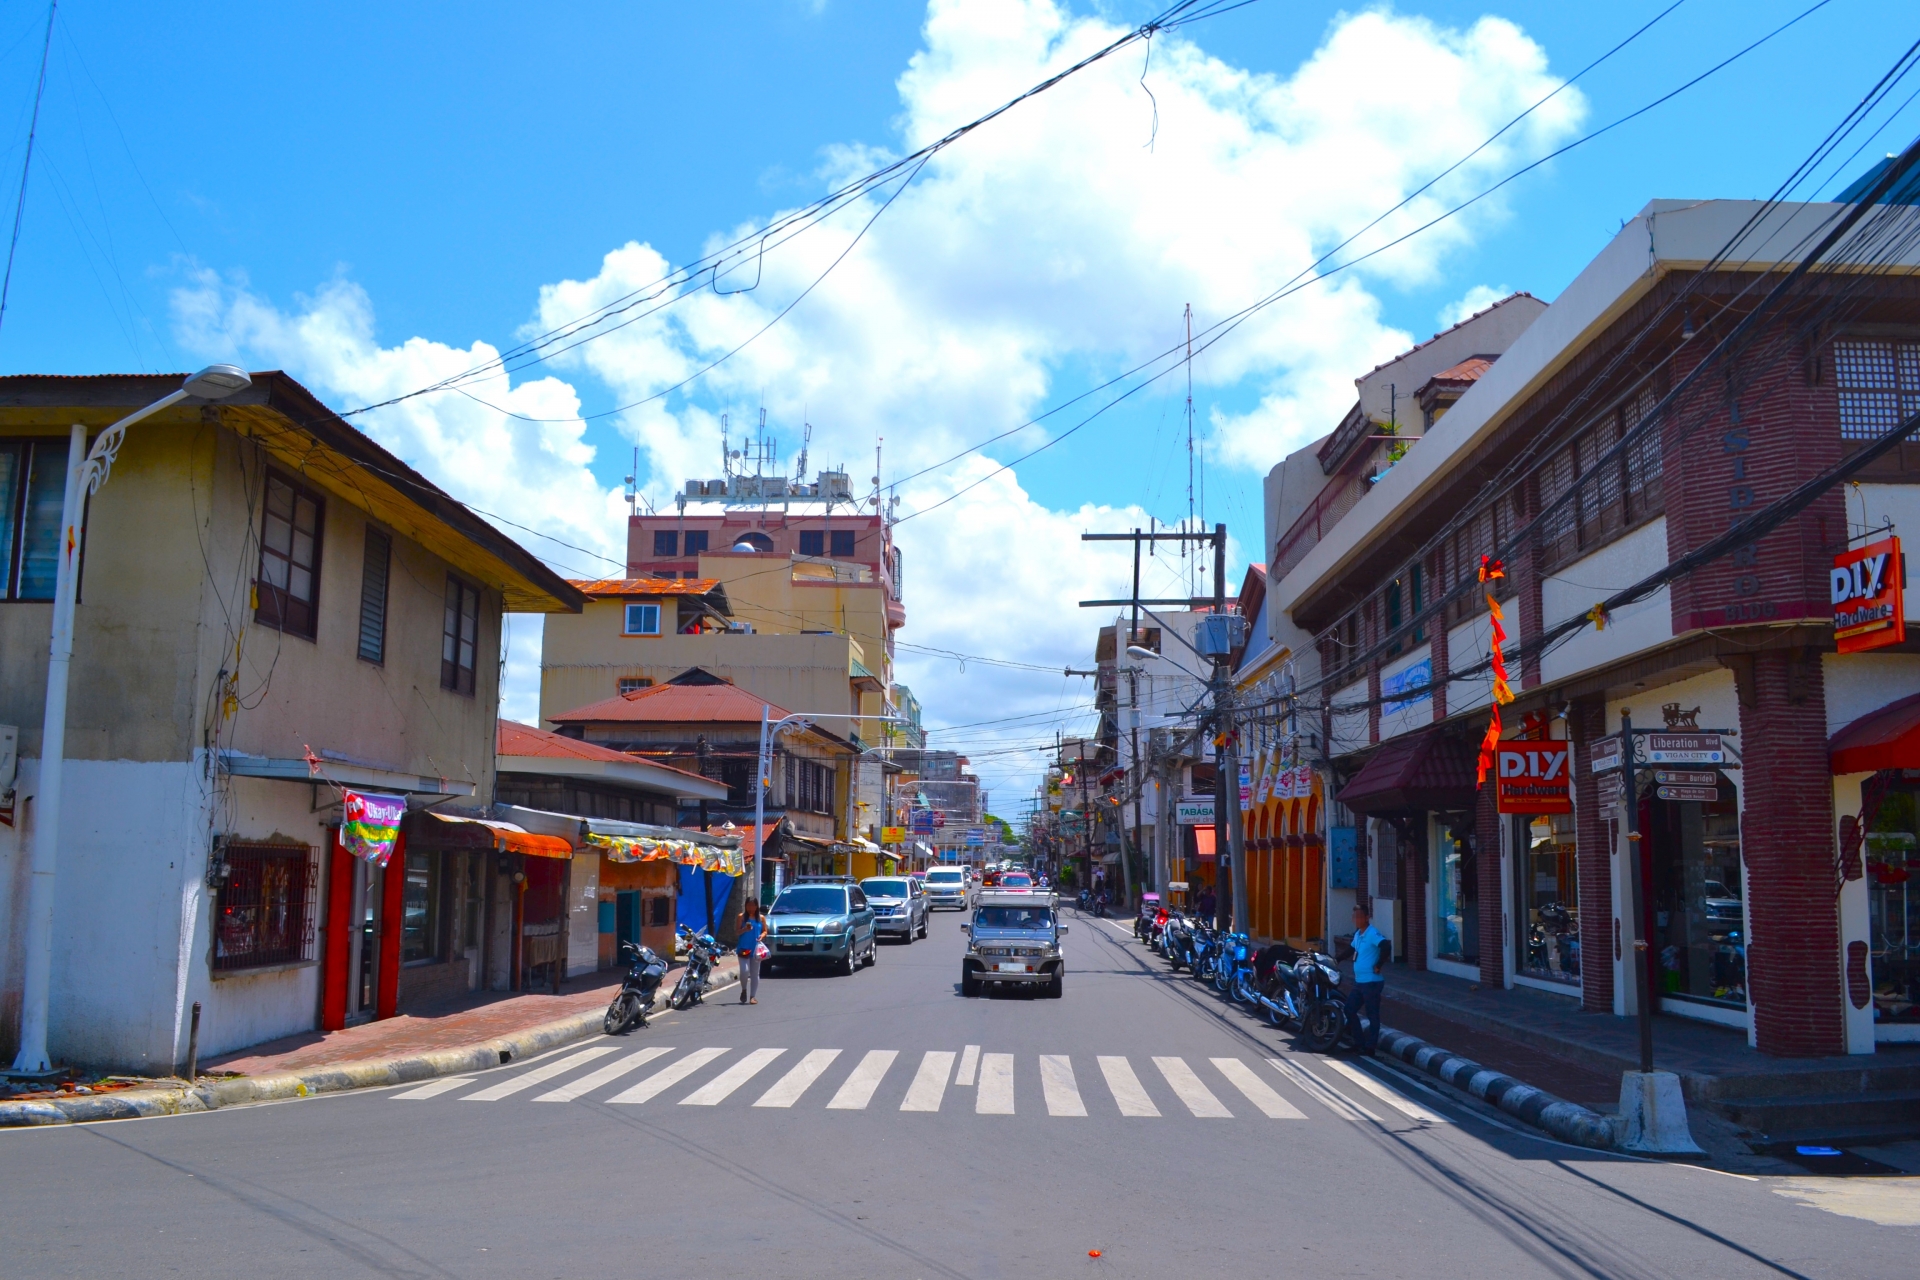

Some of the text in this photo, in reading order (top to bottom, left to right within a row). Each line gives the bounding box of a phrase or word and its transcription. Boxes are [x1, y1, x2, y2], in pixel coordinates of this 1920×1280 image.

[1725, 602, 1779, 621] BLDG.
[1834, 604, 1890, 629] Hardware
[1653, 738, 1699, 748] Liberation
[1502, 783, 1568, 796] Hardware
